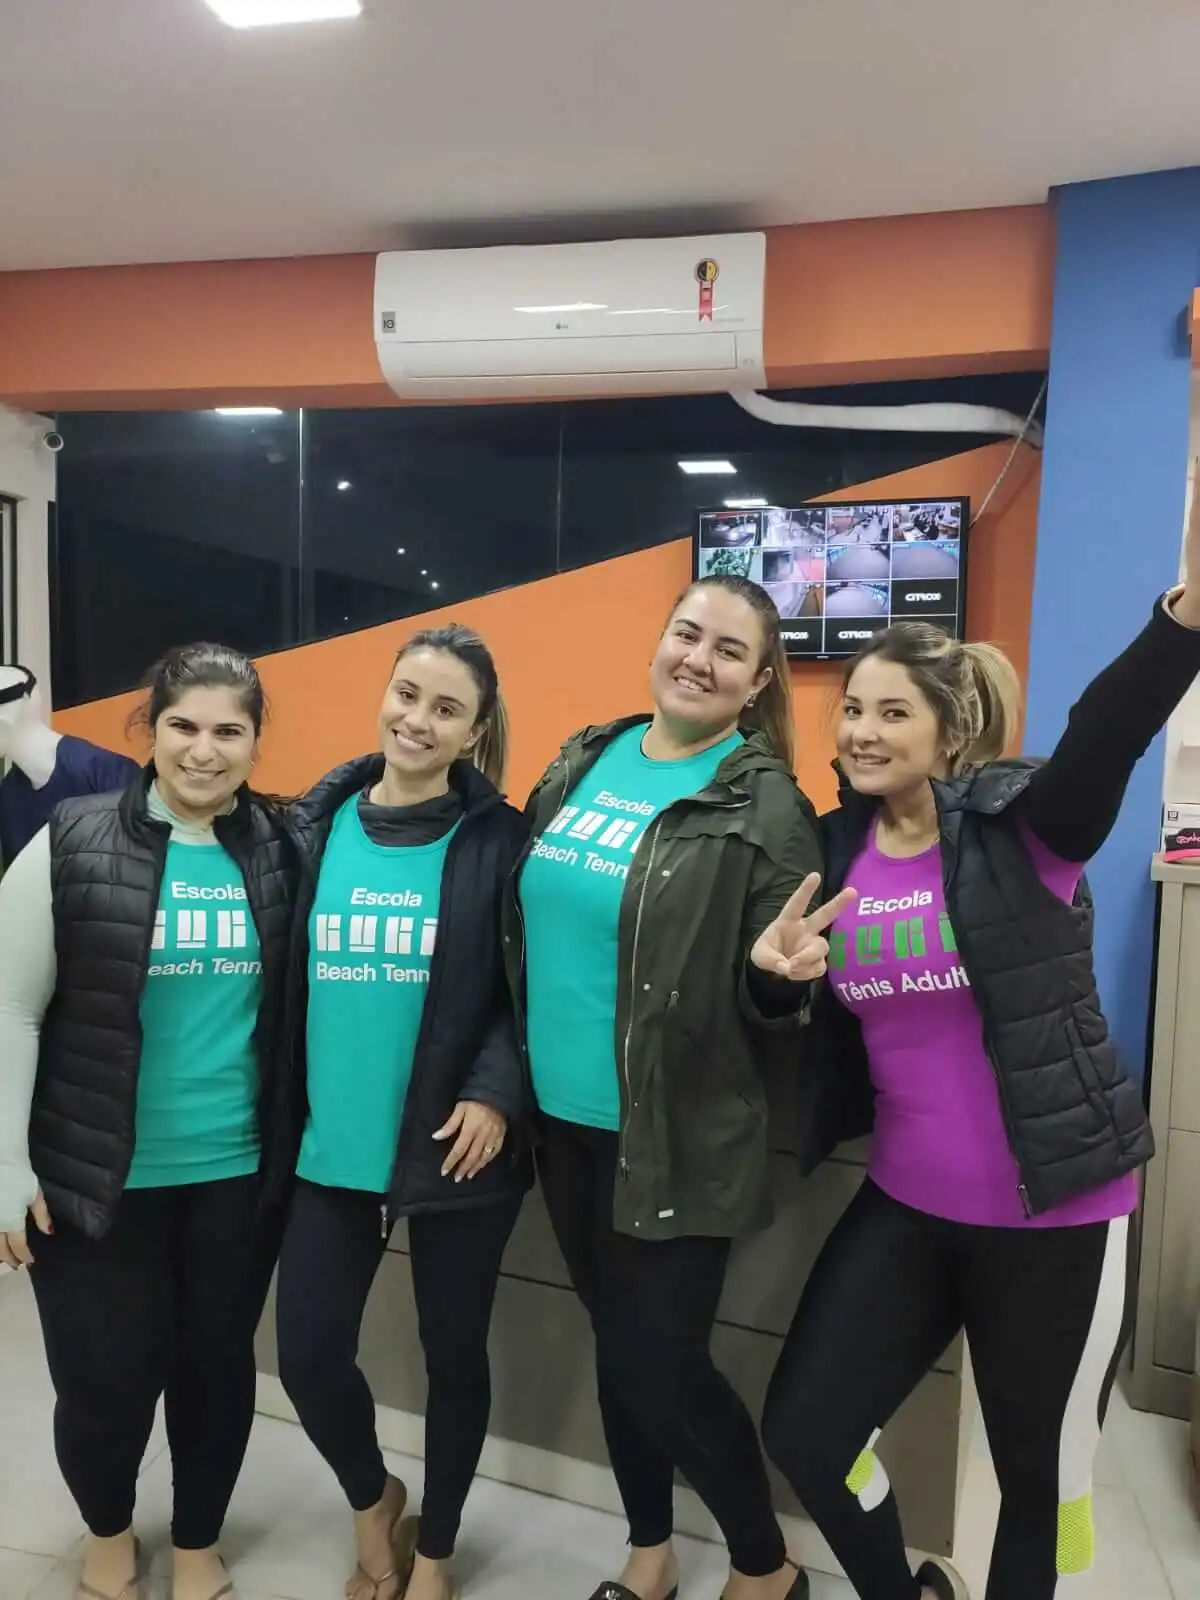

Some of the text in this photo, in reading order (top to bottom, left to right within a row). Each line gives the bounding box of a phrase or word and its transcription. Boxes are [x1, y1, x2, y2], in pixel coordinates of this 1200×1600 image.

[592, 790, 656, 816] Escola
[584, 851, 629, 880] Tenn
[171, 881, 248, 900] Escola
[350, 887, 423, 907] Escola
[857, 890, 933, 916] Escola
[147, 957, 263, 976] each Tenn
[316, 961, 430, 983] Beach Tenn
[837, 965, 971, 1002] Tênis Adult
